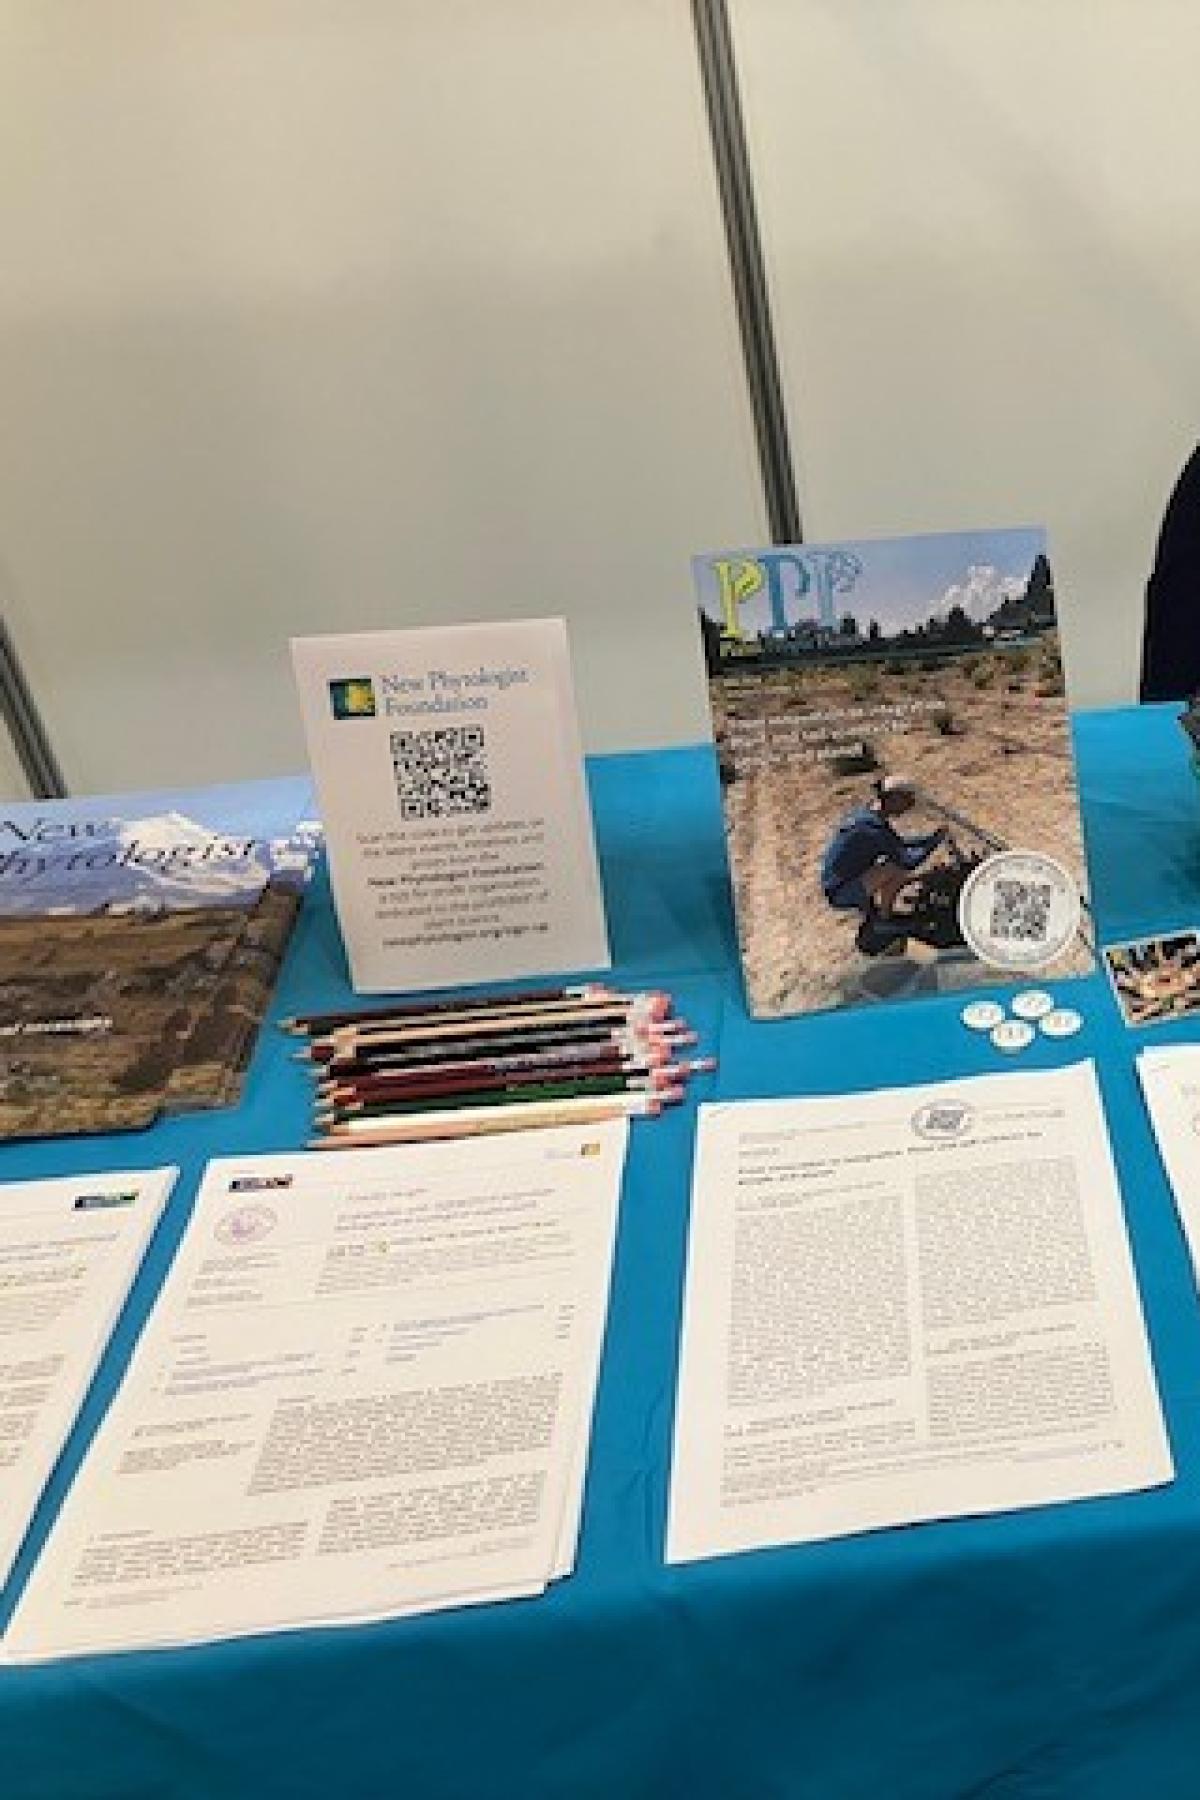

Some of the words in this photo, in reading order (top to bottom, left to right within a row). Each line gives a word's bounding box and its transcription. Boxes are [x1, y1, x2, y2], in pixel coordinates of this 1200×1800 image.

[380, 673, 424, 694] New
[427, 665, 530, 691] Phytologist
[384, 694, 489, 717] Foundation
[0, 817, 112, 842] New
[0, 838, 258, 883] hytologist
